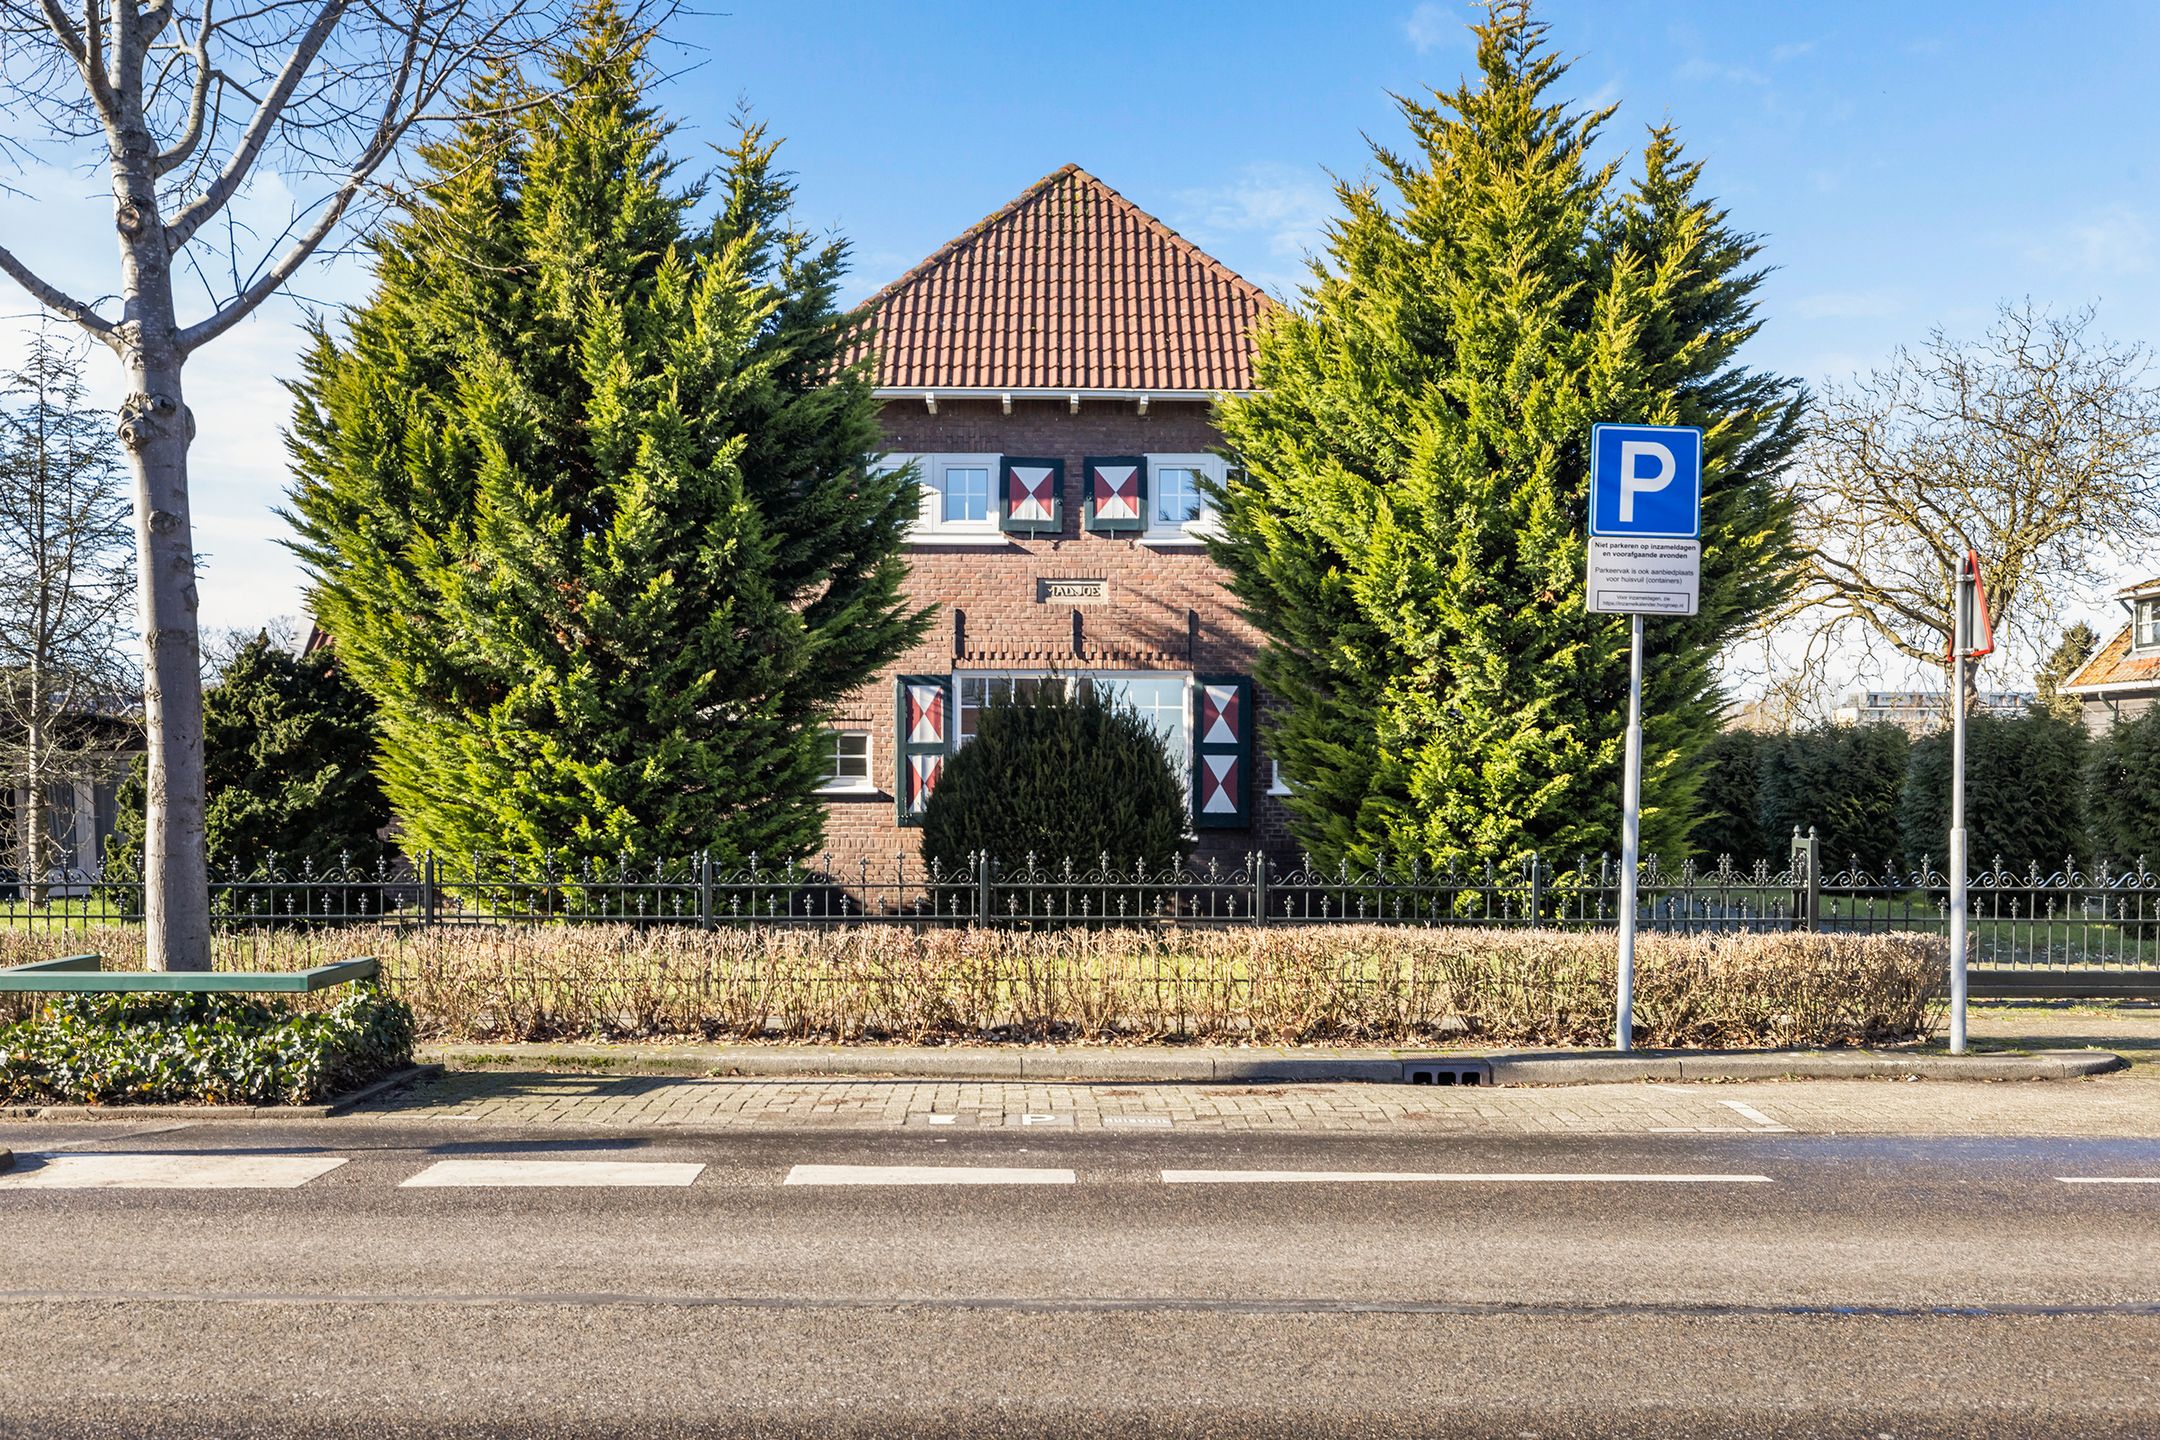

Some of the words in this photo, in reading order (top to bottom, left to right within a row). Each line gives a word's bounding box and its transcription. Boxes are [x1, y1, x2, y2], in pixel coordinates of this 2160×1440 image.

[1619, 440, 1676, 523] P
[1609, 542, 1639, 551] parkeren
[1650, 543, 1696, 552] inzameldagen
[1612, 551, 1658, 559] voorafgaande
[1595, 566, 1630, 574] Parkeervak
[1650, 568, 1694, 577] aanbiedplaats
[1645, 577, 1683, 585] (containers)
[1022, 1114, 1056, 1126] P
